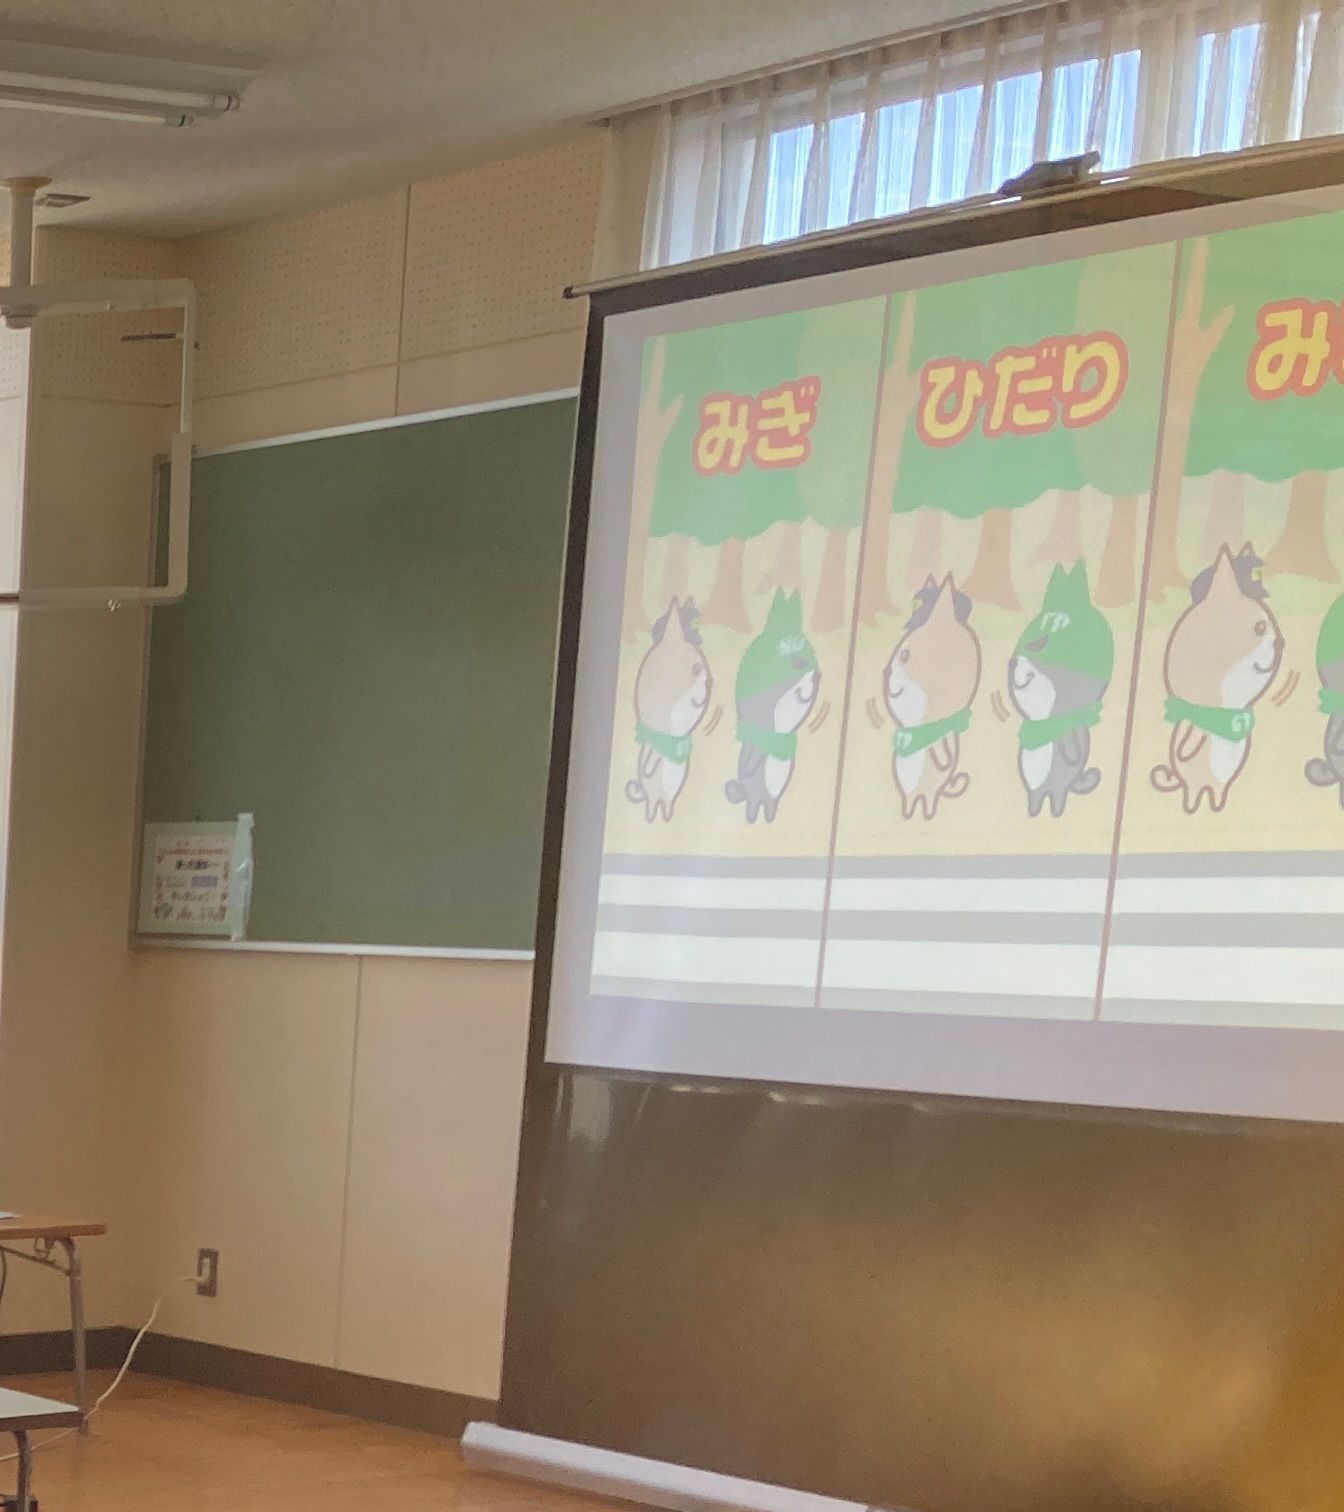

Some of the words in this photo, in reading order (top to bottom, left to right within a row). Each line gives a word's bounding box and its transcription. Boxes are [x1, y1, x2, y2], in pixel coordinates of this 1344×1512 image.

[919, 333, 1127, 445] ひだり
[1250, 300, 1344, 399] み
[694, 378, 819, 473] みぎ
